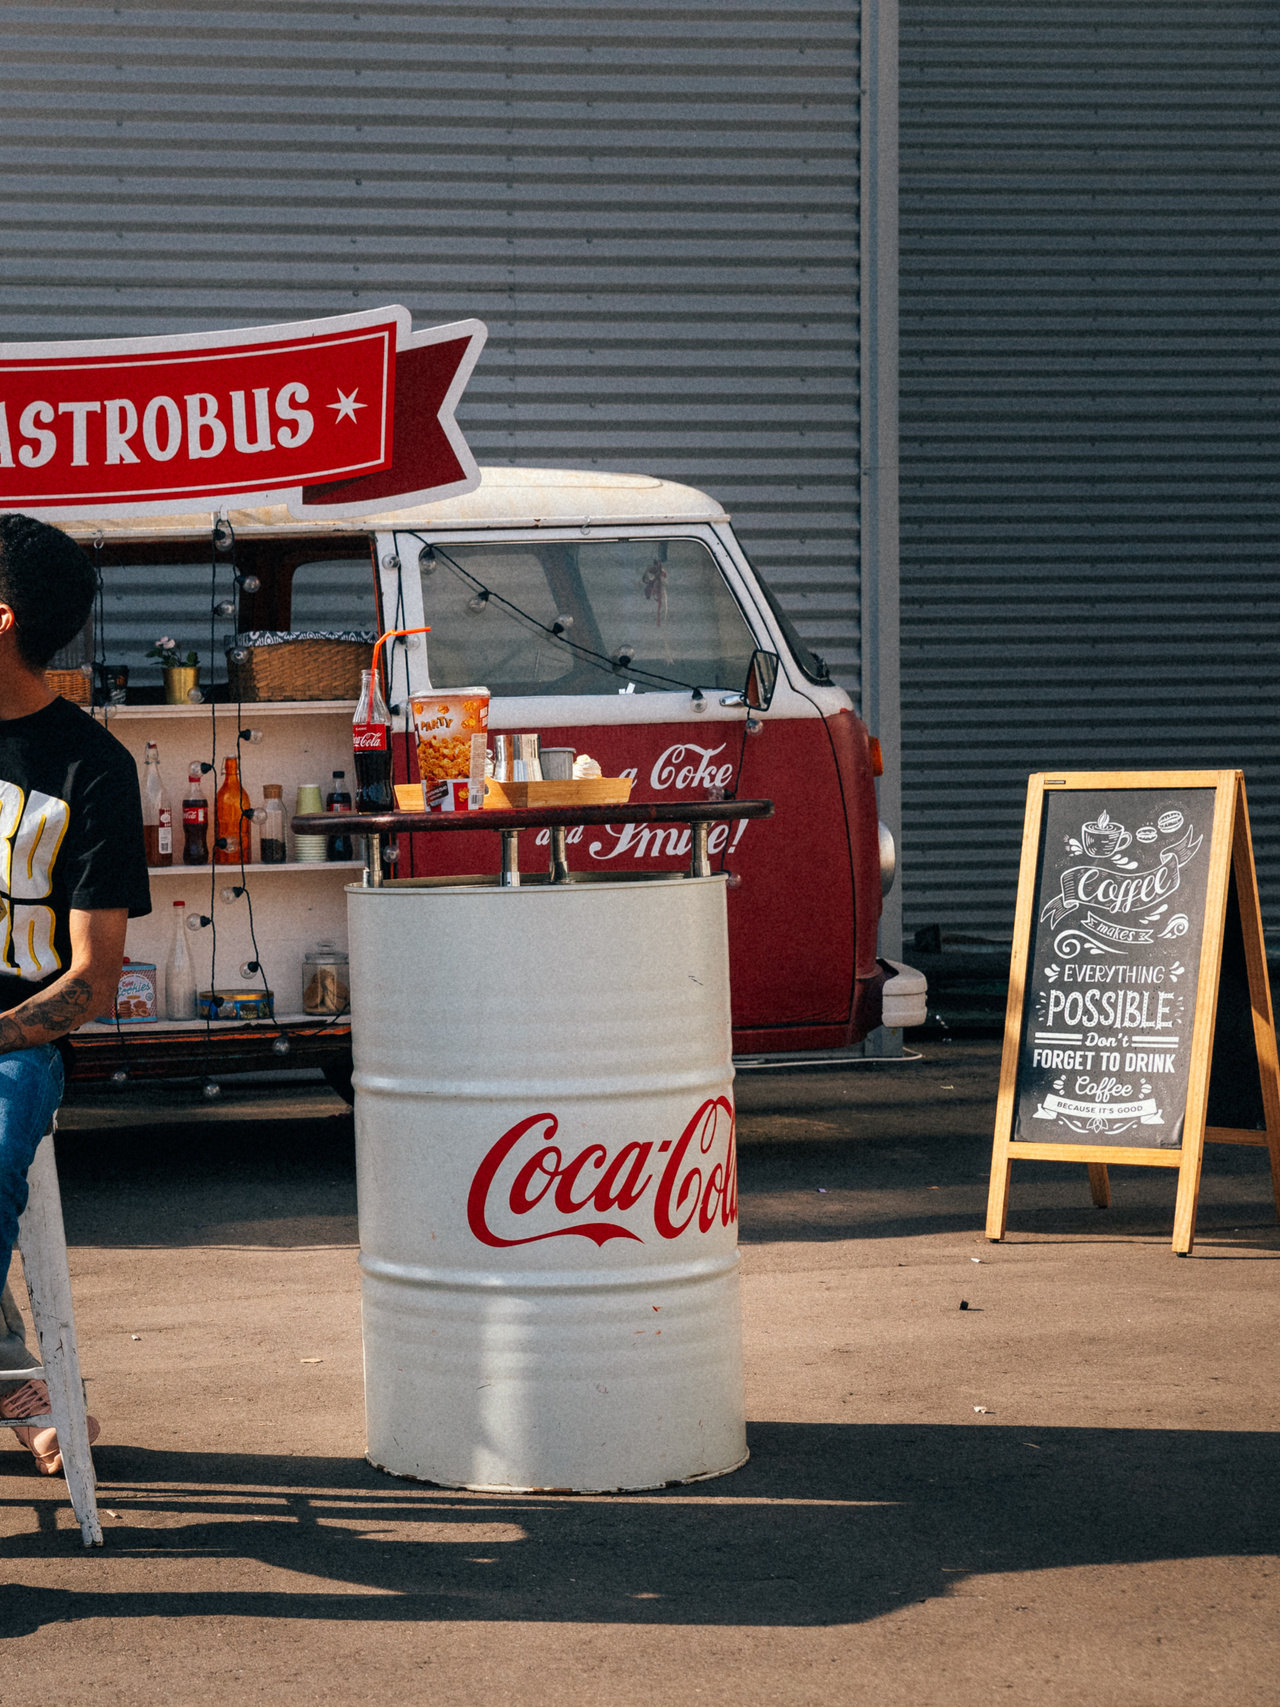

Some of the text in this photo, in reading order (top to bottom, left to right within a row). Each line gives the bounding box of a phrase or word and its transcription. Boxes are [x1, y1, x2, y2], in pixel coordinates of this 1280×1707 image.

[420, 715, 454, 732] PARTY
[649, 742, 733, 790] Coke
[535, 819, 749, 860] ad Smie!
[1077, 866, 1172, 914] Coffee
[1096, 923, 1136, 941] makes
[1063, 964, 1166, 984] EVERYTHING
[1046, 988, 1175, 1030] POSSIBLE
[1084, 1032, 1130, 1047] Don't
[1032, 1049, 1176, 1074] FORGET TO DRINK
[1075, 1075, 1134, 1103] Coffee
[1056, 1101, 1096, 1114] BECAUSE
[1117, 1105, 1143, 1114] GOOD
